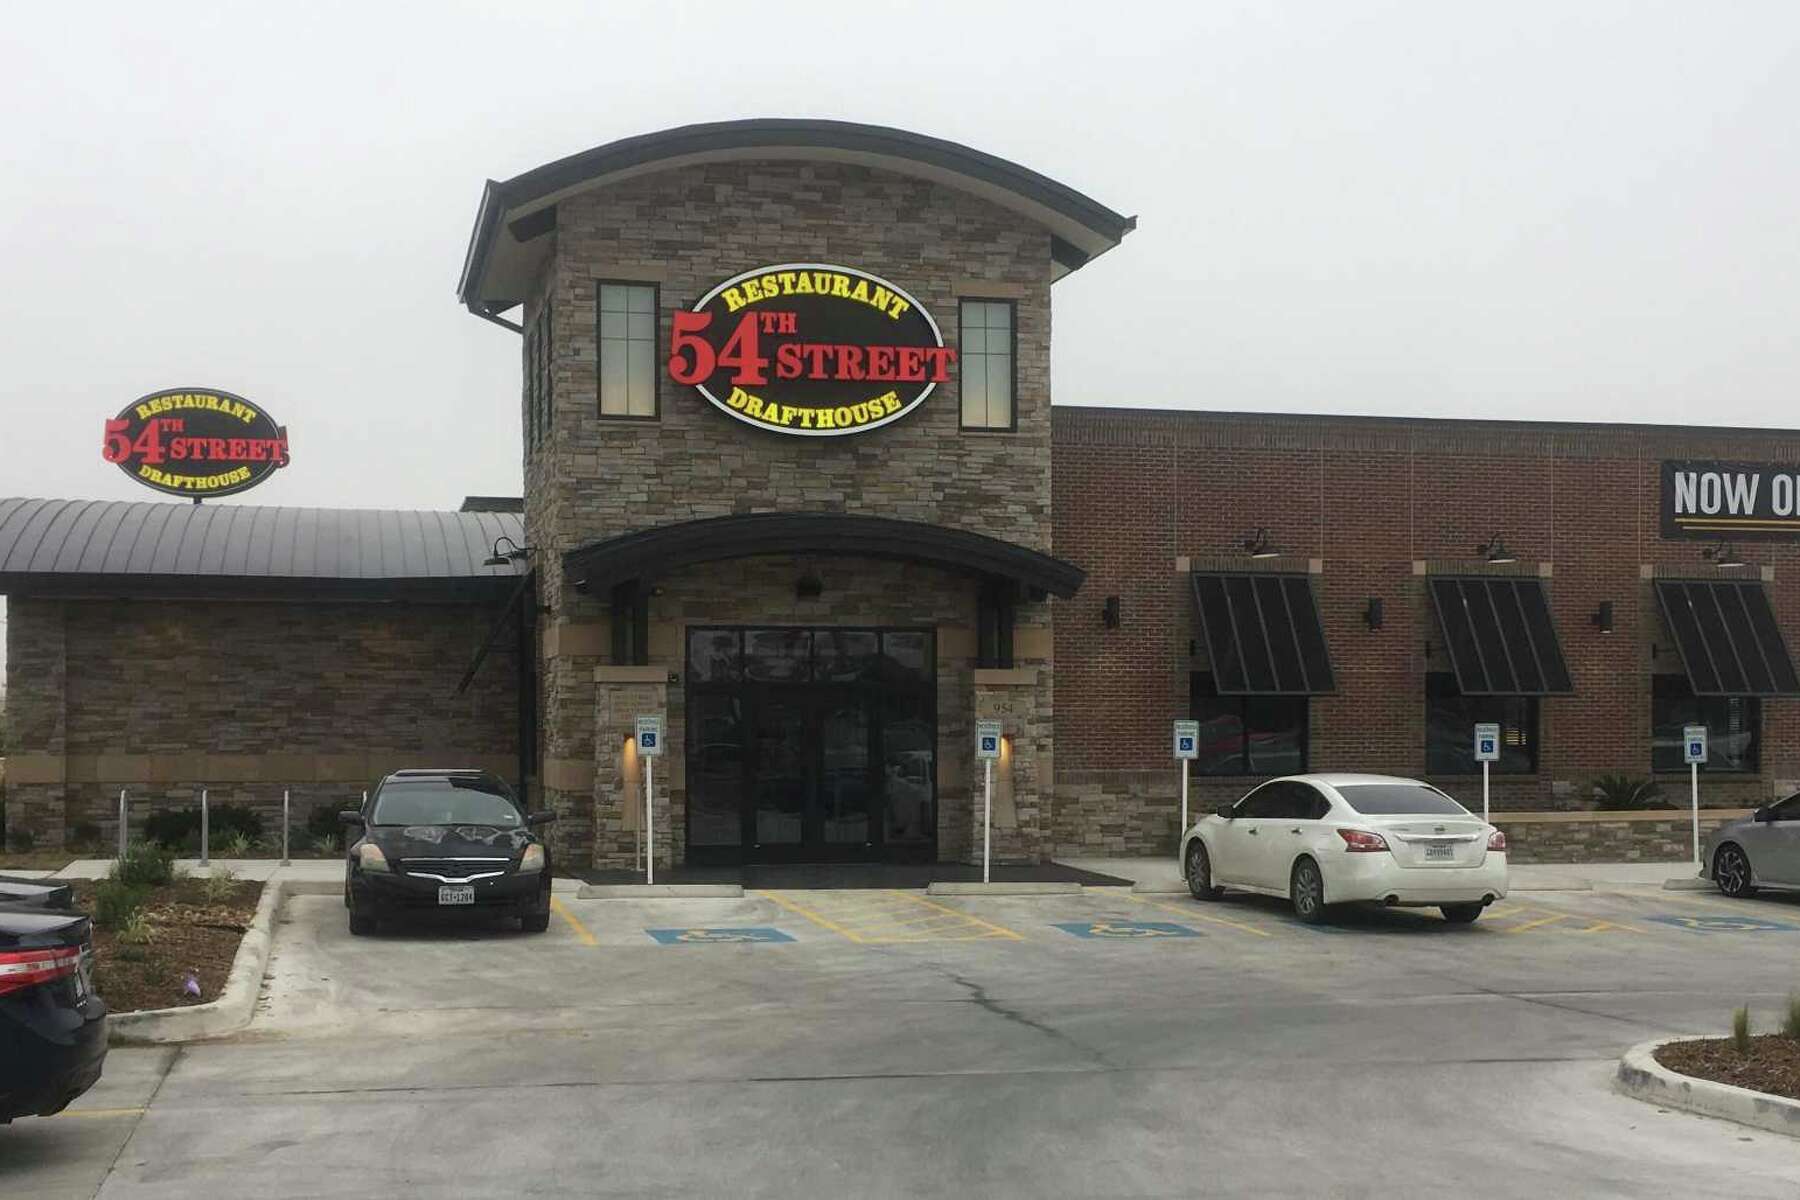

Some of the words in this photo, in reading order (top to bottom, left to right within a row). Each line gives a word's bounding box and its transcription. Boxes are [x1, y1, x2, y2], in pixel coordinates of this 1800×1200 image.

[721, 272, 910, 320] RESTAURANT
[776, 343, 957, 383] STREET
[136, 395, 256, 423] RESTAURANT
[726, 387, 901, 428] DRAFTHOUSE
[170, 437, 283, 462] STREET
[139, 465, 251, 489] DRAFTHOUSE
[1674, 471, 1760, 515] NOW
[1771, 473, 1800, 516] O
